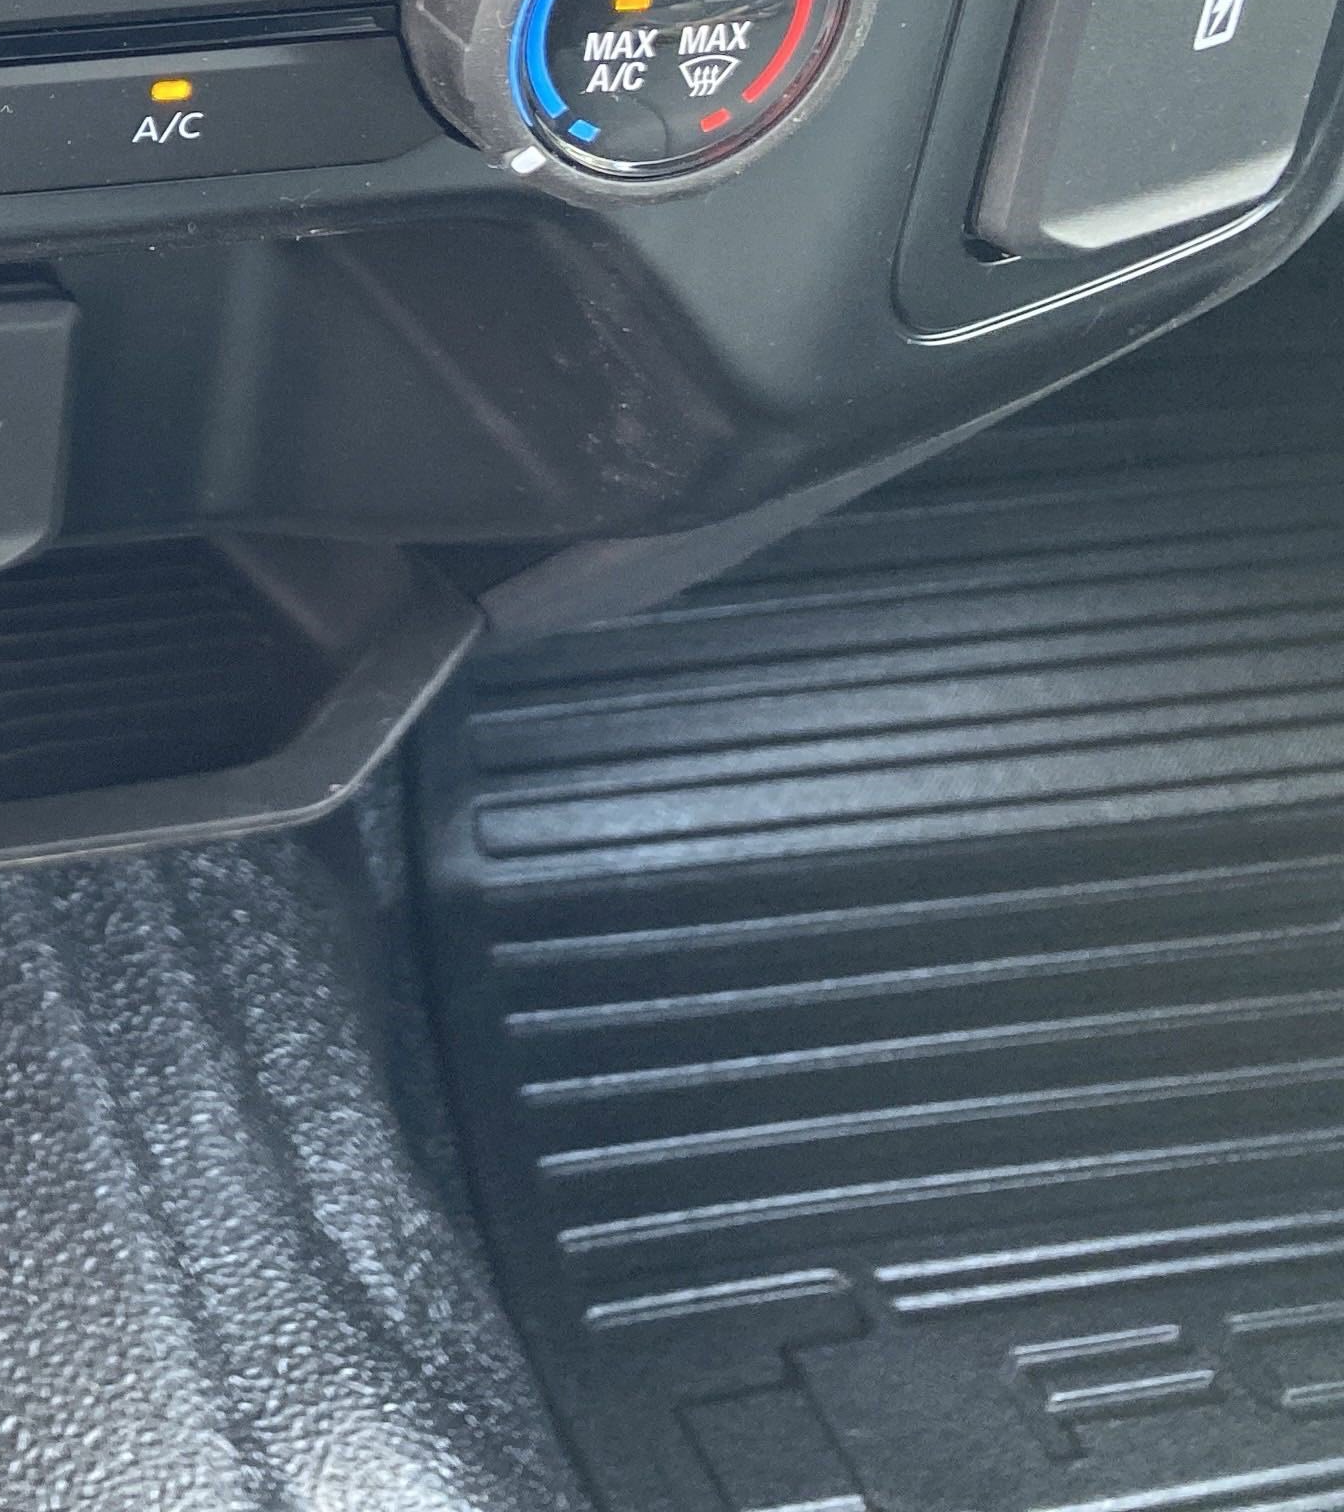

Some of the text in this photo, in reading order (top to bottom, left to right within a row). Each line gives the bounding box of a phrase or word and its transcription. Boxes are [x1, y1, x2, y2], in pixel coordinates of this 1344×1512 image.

[582, 27, 658, 63] MAX
[677, 19, 753, 55] MAX
[585, 60, 648, 94] A/C
[131, 110, 205, 145] A/C
